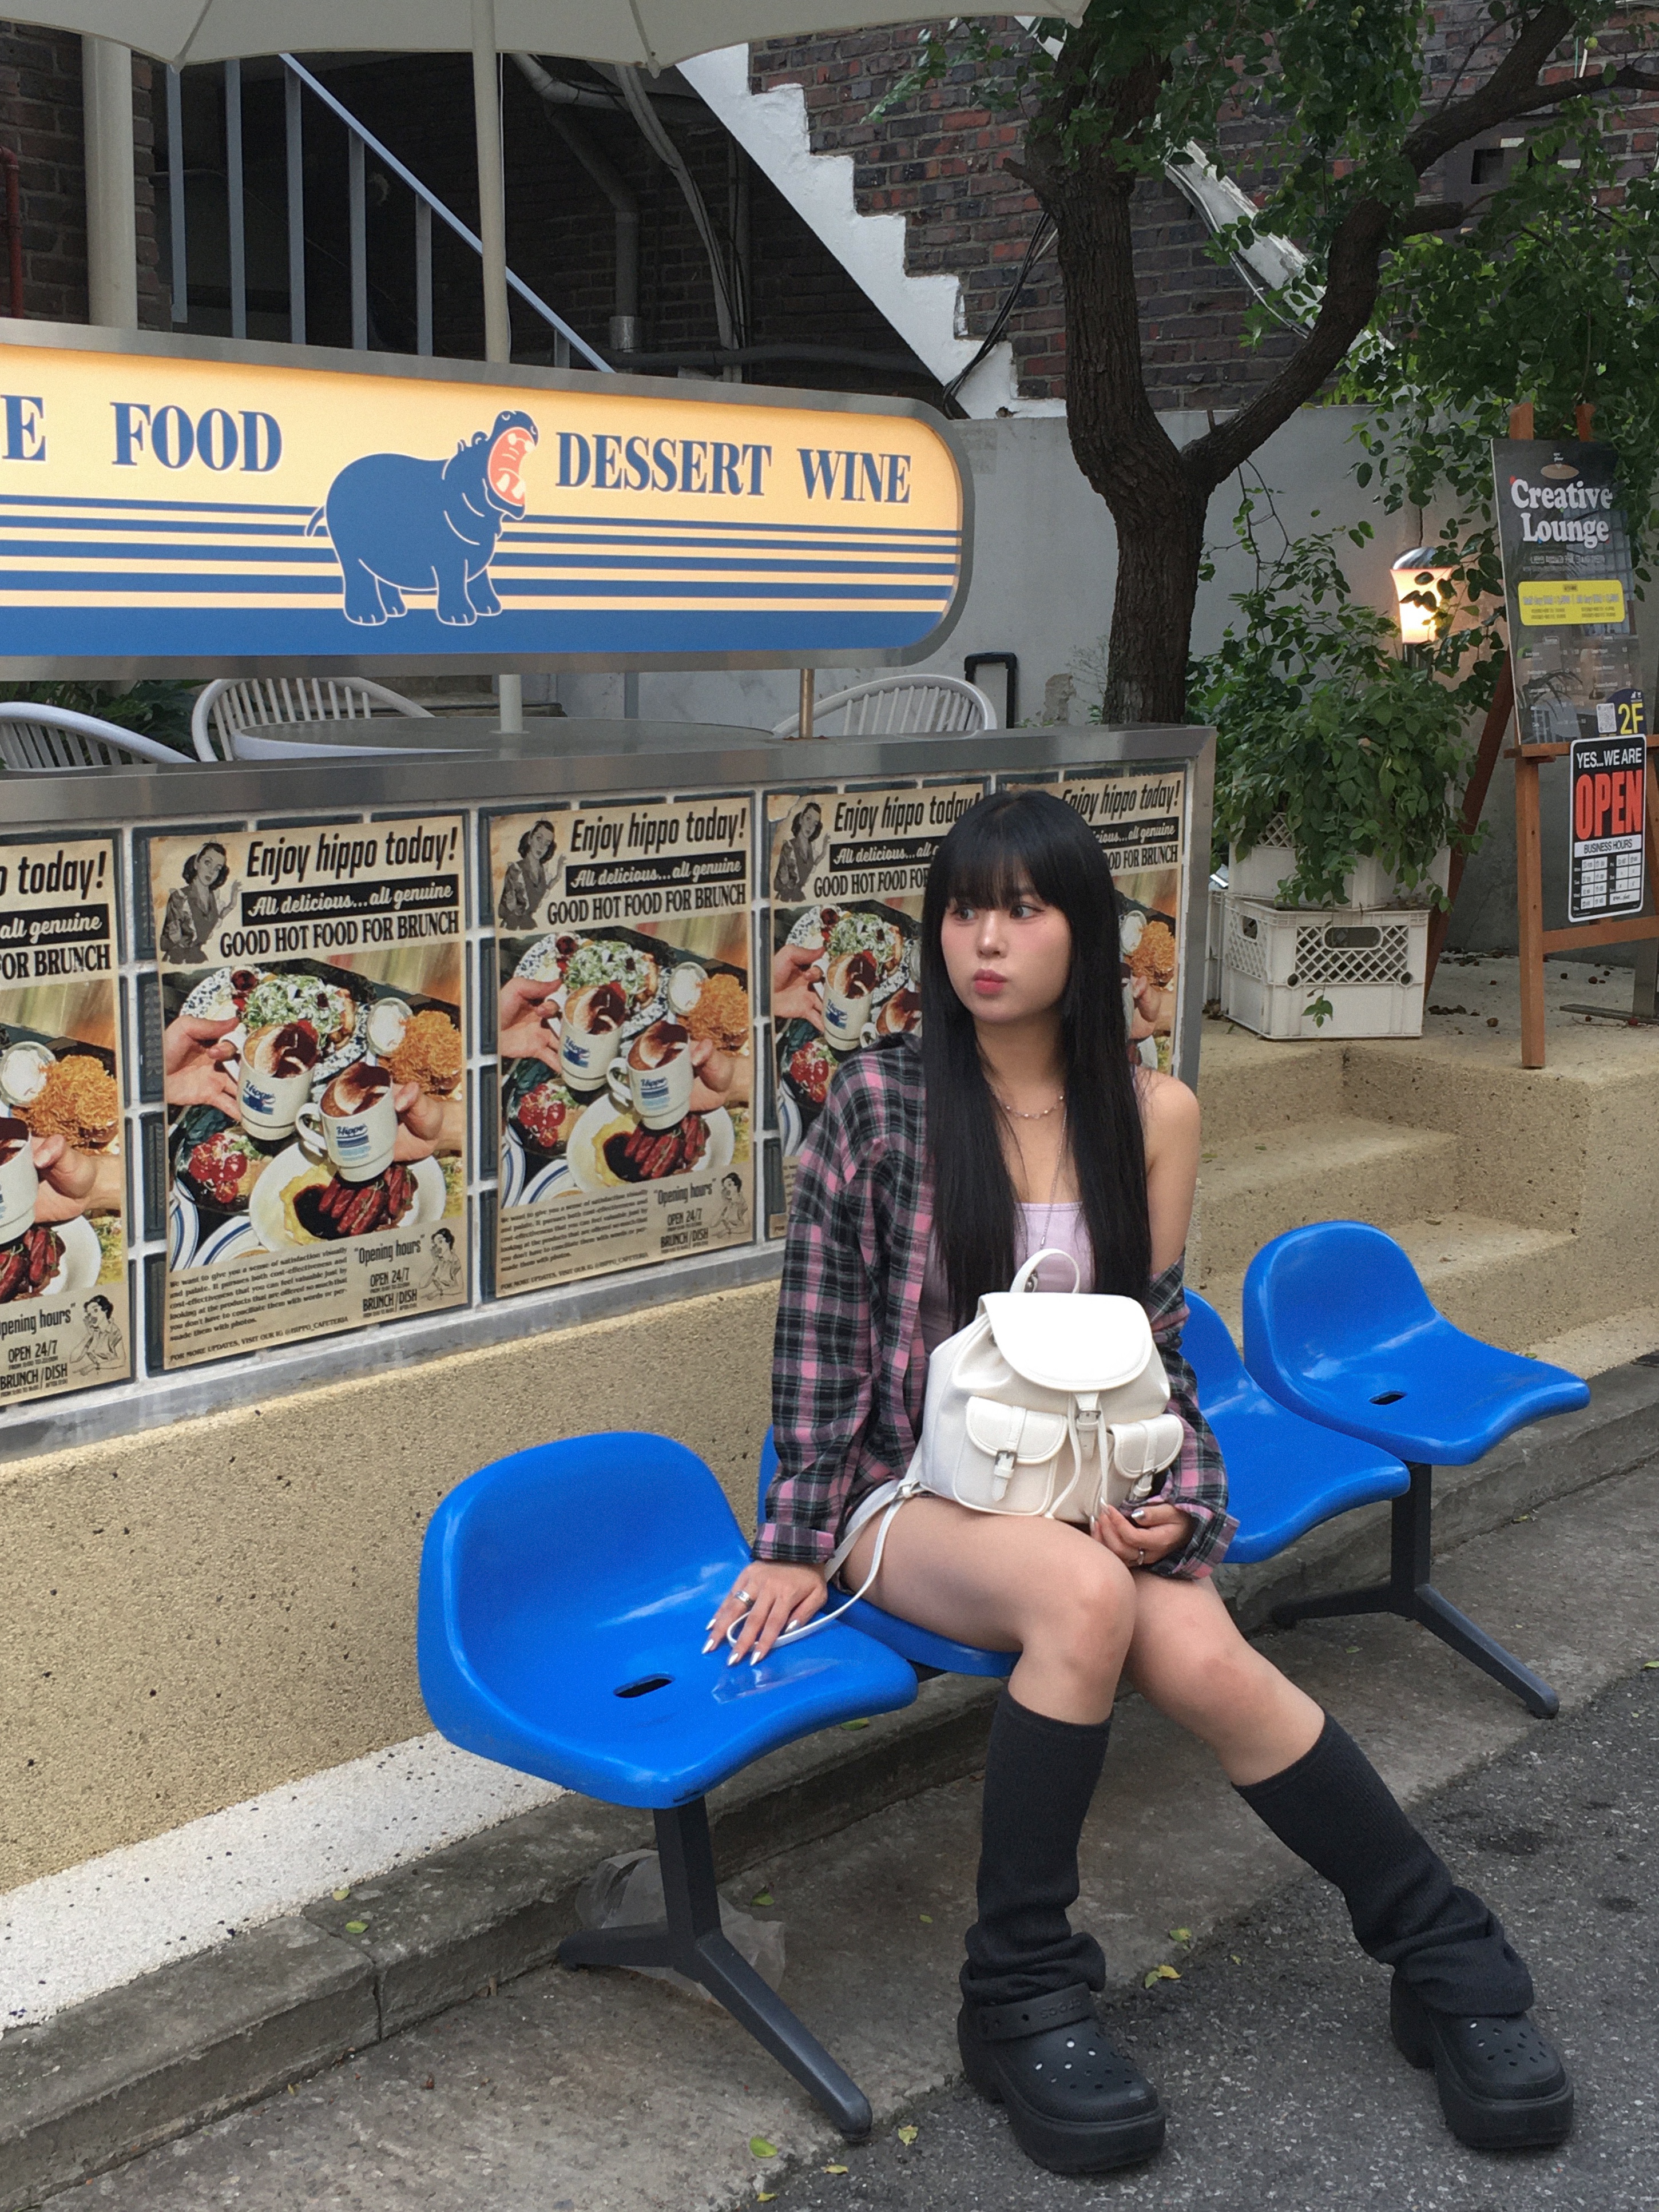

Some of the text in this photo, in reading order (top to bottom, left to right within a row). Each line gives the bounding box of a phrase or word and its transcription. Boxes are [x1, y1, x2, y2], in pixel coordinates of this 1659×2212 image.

[110, 402, 282, 472] FOOD
[555, 432, 772, 496] DESSERT
[797, 448, 912, 504] WINE
[1511, 478, 1613, 509] Creative
[1521, 513, 1609, 549] Lounge
[1618, 702, 1644, 734] 2F
[1621, 747, 1642, 765] ARE
[1100, 784, 1137, 820] hippo
[1139, 780, 1181, 814] today!
[1575, 769, 1643, 840] OPEN
[570, 807, 747, 859] Enjoy hippo today!
[834, 799, 879, 839] Enjoy
[881, 796, 925, 835] hippo
[1140, 822, 1176, 844] genuine
[246, 826, 458, 885] Enjoy hippo today!
[833, 848, 855, 865] All
[1123, 849, 1140, 869] FOR
[1141, 844, 1178, 867] BRUNCH
[1583, 839, 1633, 854] BUSINESS HOURS
[18, 849, 107, 900] today!
[570, 869, 597, 888] All
[692, 857, 742, 883] genuine
[813, 876, 848, 898] GOOD
[851, 872, 876, 895] HOT
[878, 869, 907, 892] FOOD
[247, 896, 279, 917] All
[393, 881, 454, 910] genuine
[547, 883, 747, 925] GOOD HOT FOOD FOR BRUNCH
[30, 913, 102, 944] genuine
[220, 911, 460, 958] GOOD HOT FOOD FOR BRUNCH
[0, 944, 112, 980] OR BRUNCH
[667, 1208, 703, 1226] OPEN 24/7
[170, 1290, 182, 1298] and
[251, 1273, 268, 1281] both
[334, 1256, 347, 1265] and
[181, 1277, 199, 1285] want
[212, 1272, 227, 1281] give
[228, 1269, 241, 1277] you
[249, 1263, 269, 1271] sense
[235, 1286, 250, 1295] that
[252, 1285, 265, 1293] you
[281, 1277, 293, 1286] feel
[370, 1266, 410, 1287] OPEN 24/7
[220, 1298, 251, 1310] products
[253, 1294, 267, 1302] that
[280, 1285, 305, 1296] offered
[0, 1313, 37, 1341] pening
[170, 1324, 182, 1332] you
[204, 1315, 221, 1323] have
[267, 1301, 285, 1309] them
[287, 1297, 301, 1305] with
[193, 1327, 212, 1336] them
[213, 1323, 229, 1331] with
[8, 1345, 31, 1363] OPEN
[35, 1340, 58, 1358] 24/7
[170, 1352, 185, 1361] FOR
[241, 1335, 259, 1344] VISIT
